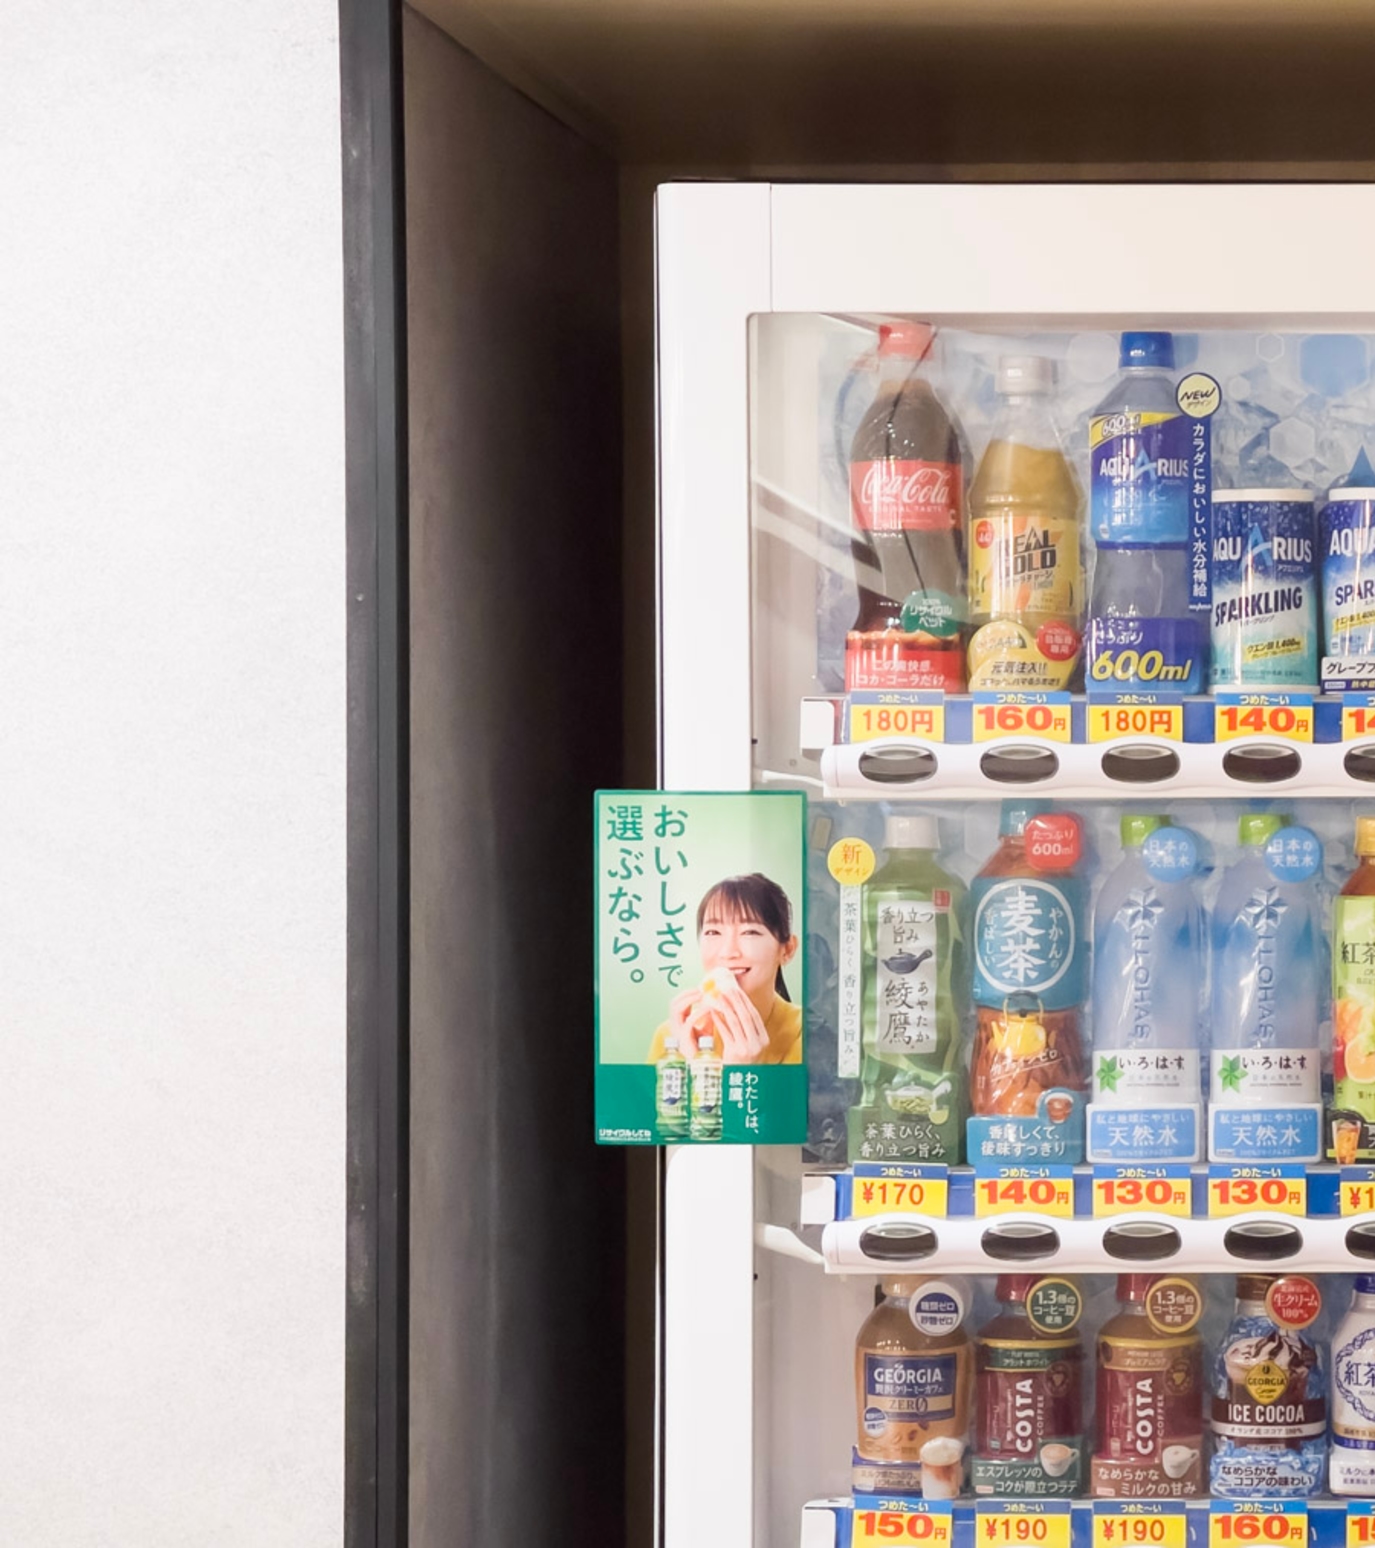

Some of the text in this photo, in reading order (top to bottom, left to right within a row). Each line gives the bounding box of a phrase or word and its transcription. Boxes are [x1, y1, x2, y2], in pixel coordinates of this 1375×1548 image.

[1180, 388, 1216, 401] NEW
[1192, 423, 1208, 597] カラダにおいしい水分補給
[1215, 588, 1302, 627] SPARKLING
[919, 616, 947, 628] ペット
[1092, 650, 1192, 681] 600ml
[862, 709, 933, 733] 180円
[978, 705, 1066, 731] 160円
[1101, 710, 1172, 733] 180円
[1221, 707, 1308, 732] 140円
[1032, 829, 1074, 840] たっぷり
[842, 845, 862, 865] 新
[1032, 843, 1073, 855] 600ml
[1149, 840, 1188, 851] 日本の
[1272, 840, 1311, 851] 日本の
[1149, 855, 1191, 867] 天然水
[1272, 855, 1314, 867] 天然水
[607, 806, 644, 983] 選ぶなら。
[654, 805, 688, 987] おいしさで
[880, 908, 934, 924] 香り立つ
[893, 927, 919, 944] 旨み
[997, 886, 1046, 982] 麦茶
[916, 981, 929, 1043] あやたか
[745, 1072, 759, 1134] わたしは、
[865, 1124, 939, 1140] 茶葉ひらく、
[1108, 1125, 1179, 1147] 天然水
[1233, 1126, 1301, 1147] 天然水
[859, 1141, 945, 1159] 香り立つ旨み
[981, 1142, 1065, 1156] 後味すっきり
[863, 1182, 924, 1205] ¥170
[981, 1180, 1069, 1205] 140円
[1097, 1180, 1186, 1204] 130円
[1212, 1180, 1301, 1204] 130円
[1274, 1293, 1318, 1307] 生クリーム
[1033, 1305, 1075, 1316] コーヒー豆
[1153, 1305, 1194, 1316] コーヒー豆
[1281, 1307, 1308, 1319] 100%
[874, 1364, 942, 1383] GEORGIA
[1248, 1377, 1285, 1386] GEORGIA
[1015, 1379, 1034, 1452] COSTA
[1136, 1379, 1153, 1455] COSTA
[1228, 1404, 1305, 1422] ICE COCOA
[976, 1466, 1043, 1477] エスプレッソの
[1098, 1468, 1159, 1480] なめらかな
[1222, 1466, 1277, 1476] なめらかな
[996, 1481, 1077, 1493] コクが際立つラテ
[1121, 1482, 1196, 1495] ミルクの甘み
[1234, 1477, 1312, 1487] ココアの味わい
[858, 1512, 946, 1539] 150円
[986, 1519, 1047, 1541] ¥190
[1103, 1519, 1165, 1542] ¥190
[1214, 1515, 1302, 1539] 160円
